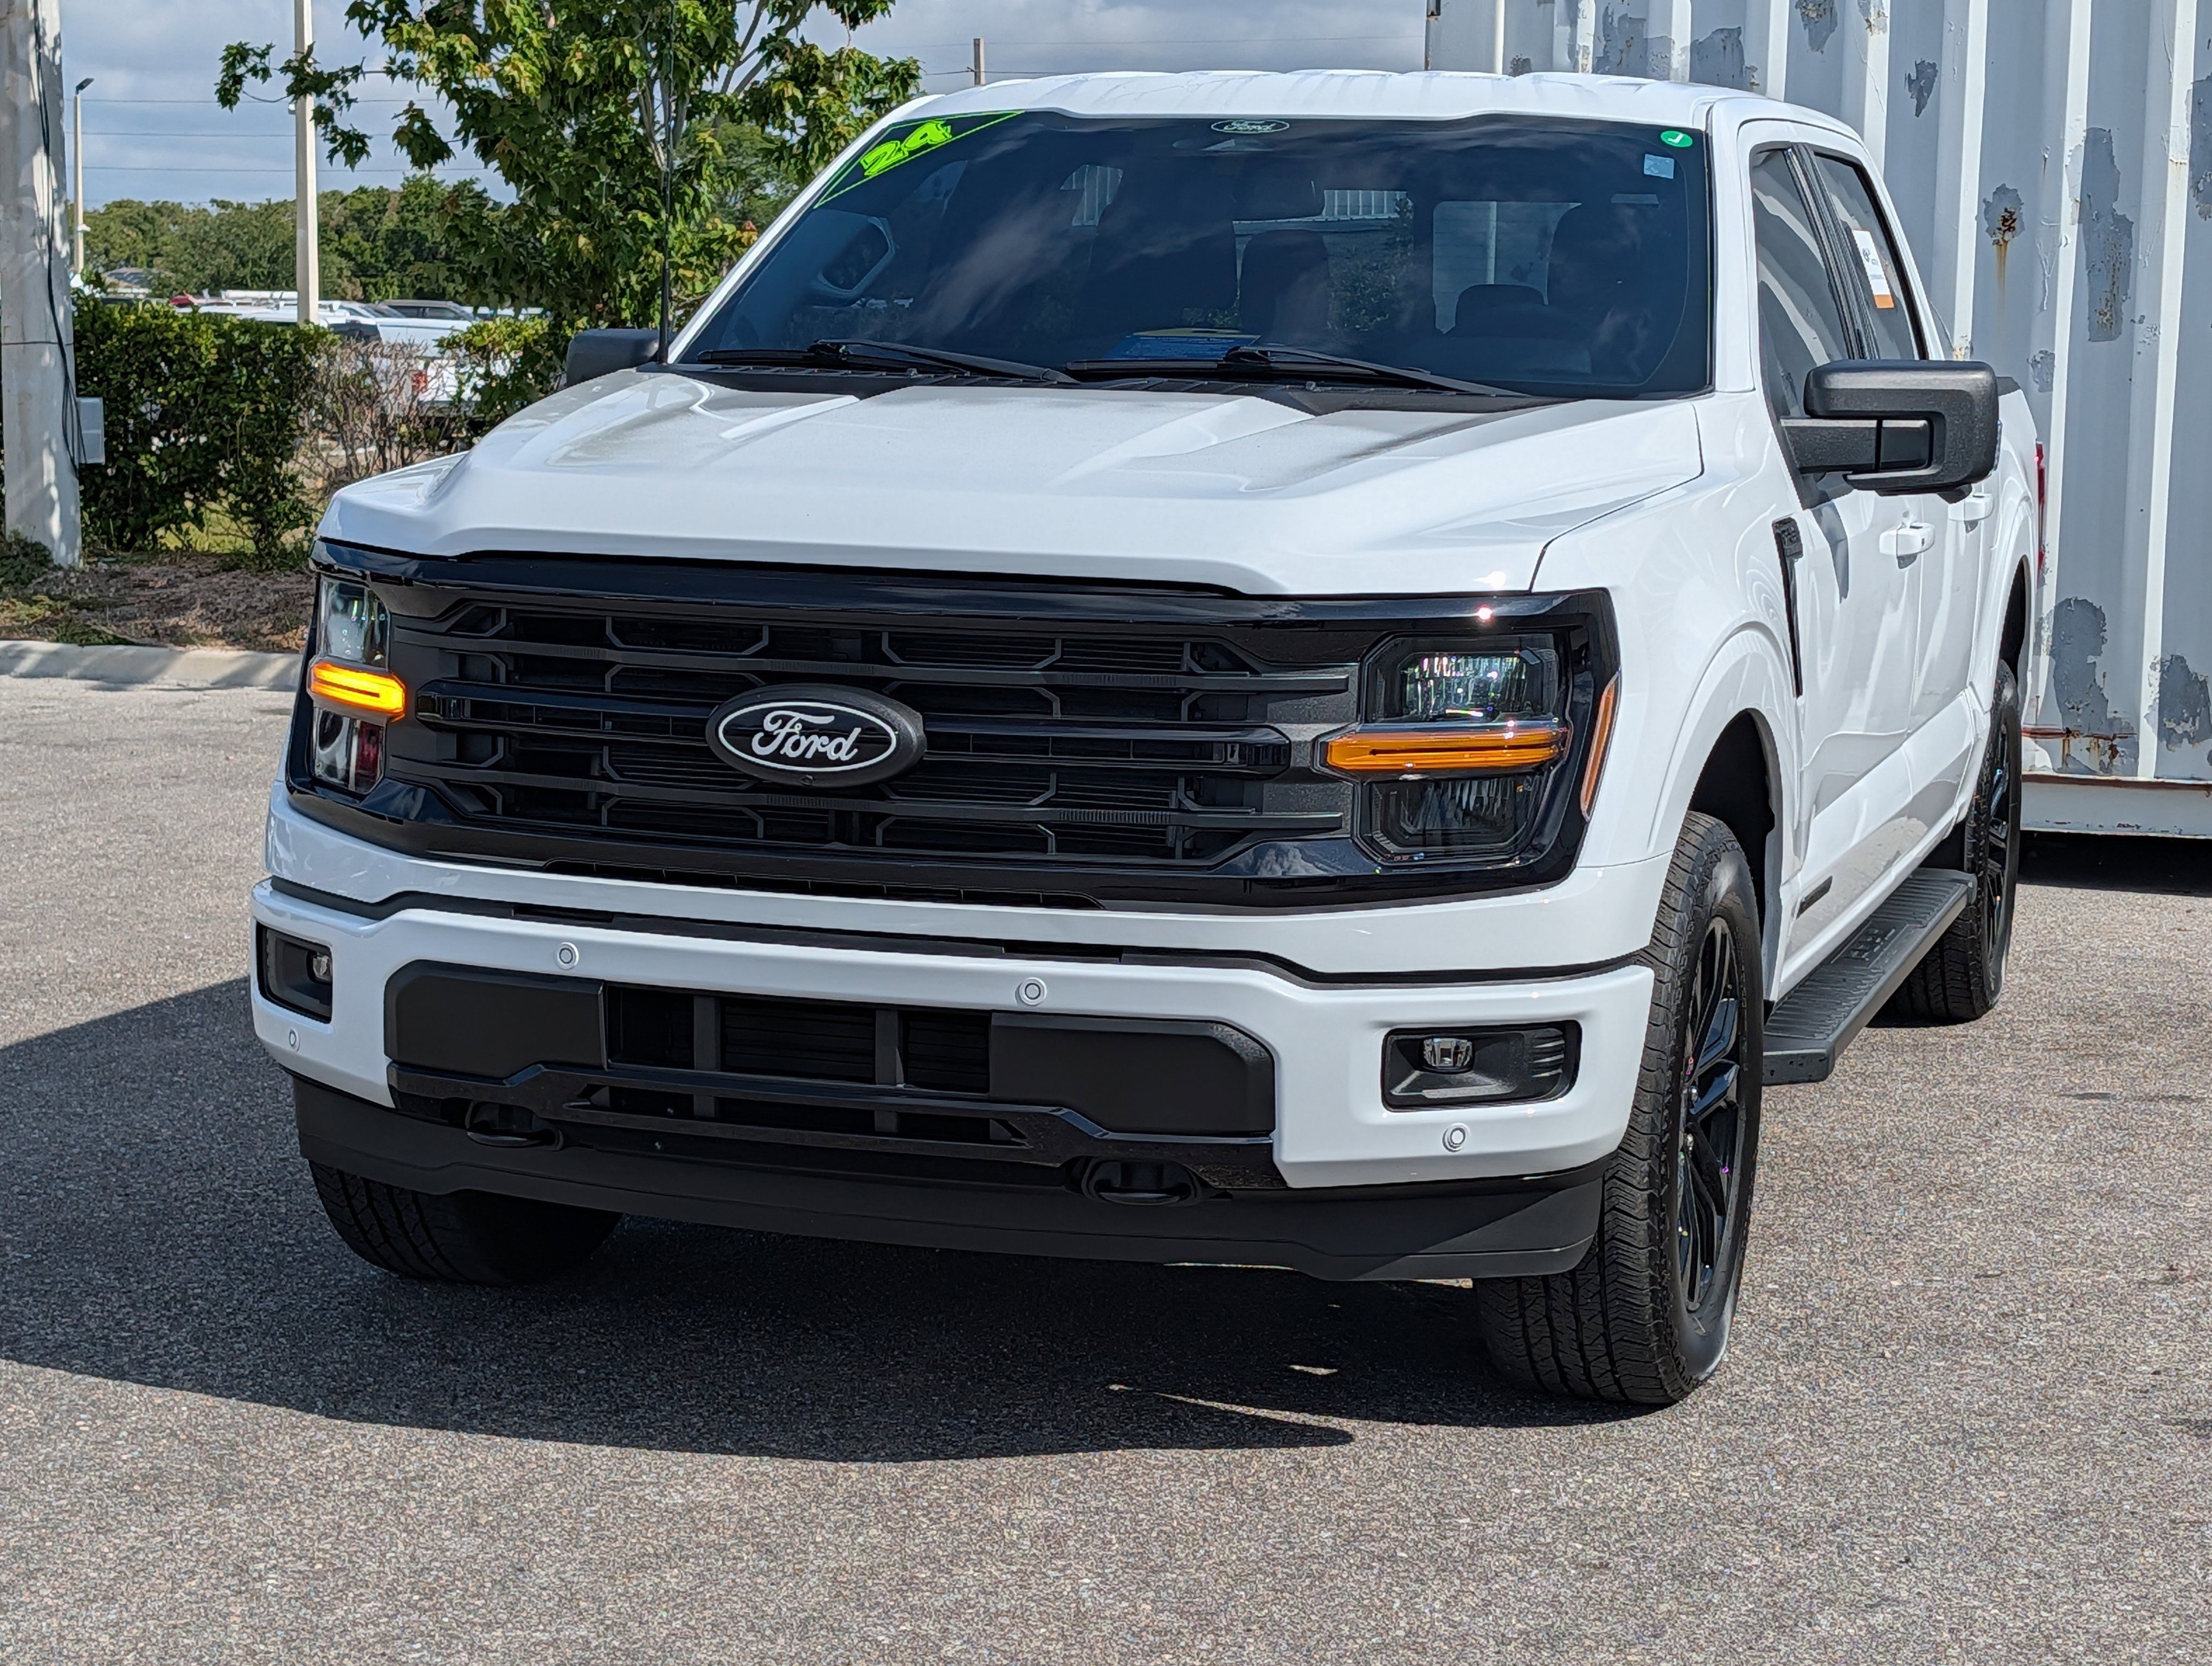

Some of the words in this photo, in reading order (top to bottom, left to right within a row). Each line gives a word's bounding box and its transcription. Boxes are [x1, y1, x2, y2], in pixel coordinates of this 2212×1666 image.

[860, 120, 952, 176] 24
[1224, 120, 1276, 132] Ford
[751, 710, 861, 761] Ford
